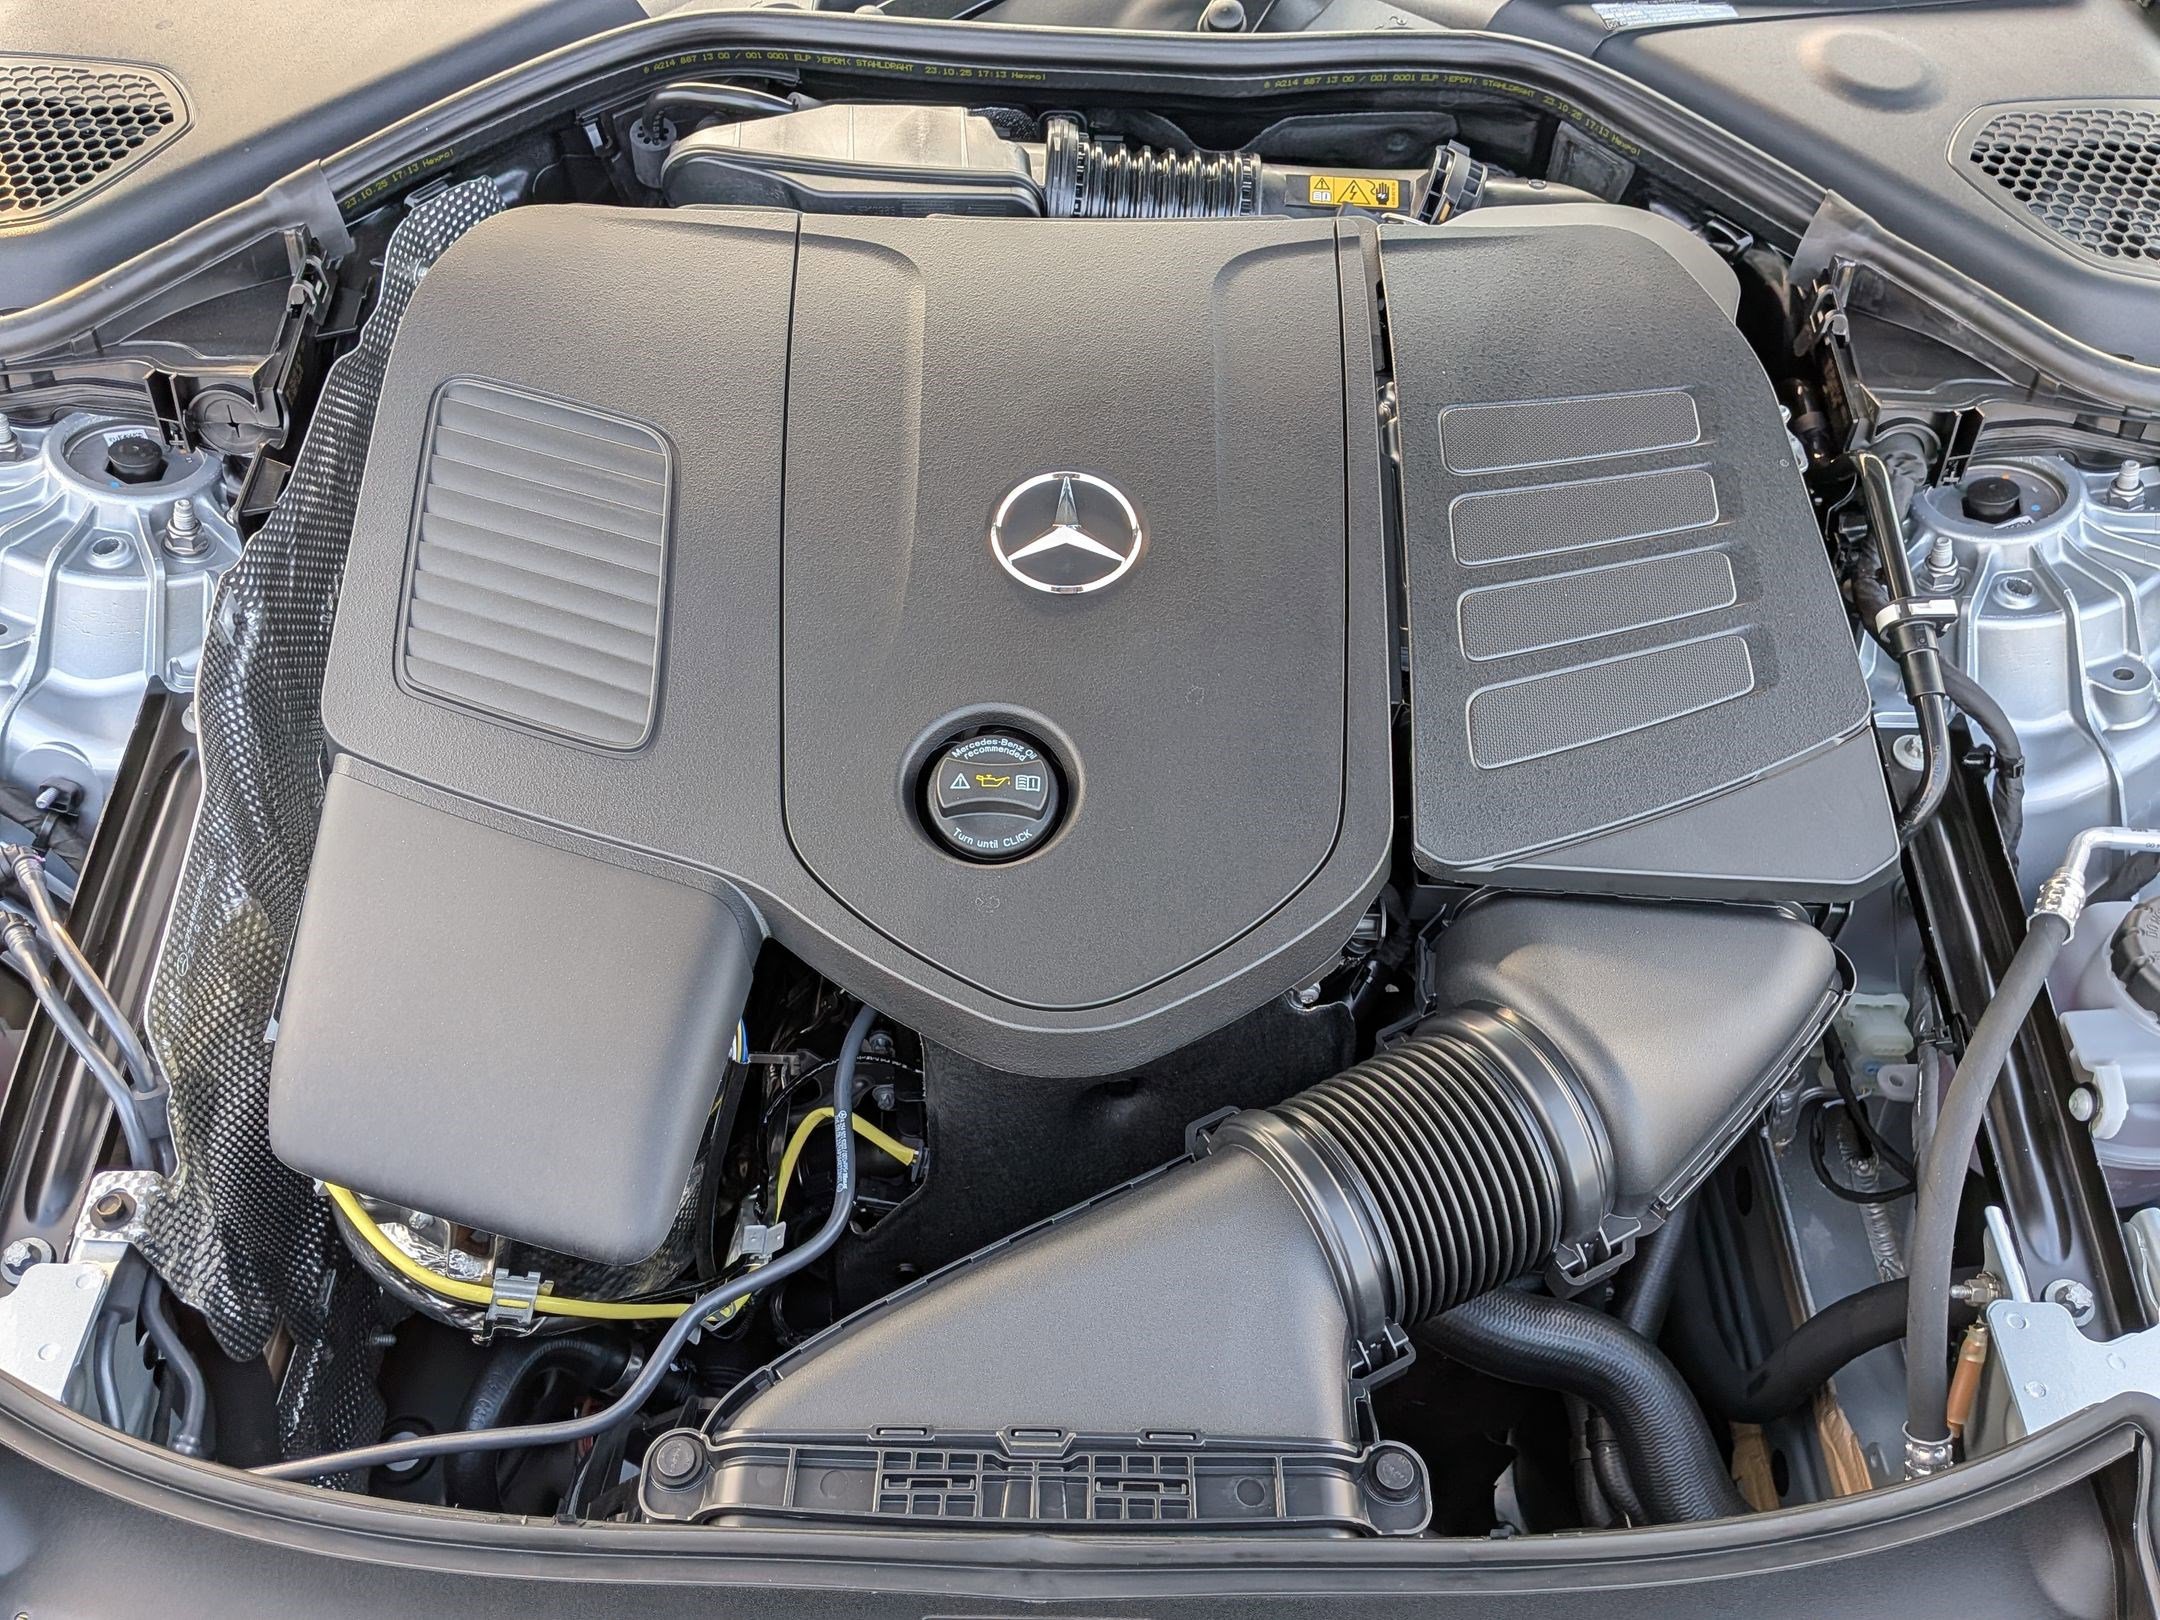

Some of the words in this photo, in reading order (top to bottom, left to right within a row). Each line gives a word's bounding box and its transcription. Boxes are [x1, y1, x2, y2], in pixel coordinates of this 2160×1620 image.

[703, 53, 713, 62] 13
[855, 59, 914, 72] STAHLDRAHT
[978, 70, 1007, 79] 17:13
[344, 180, 389, 209] 23.10.25
[391, 163, 420, 182] 17:13
[951, 738, 1025, 760] Mercedes-Benz
[1024, 748, 1038, 760] Oil
[963, 745, 1028, 762] recommended
[953, 828, 974, 845] Turn
[977, 839, 999, 849] until
[1003, 829, 1033, 847] CLICK
